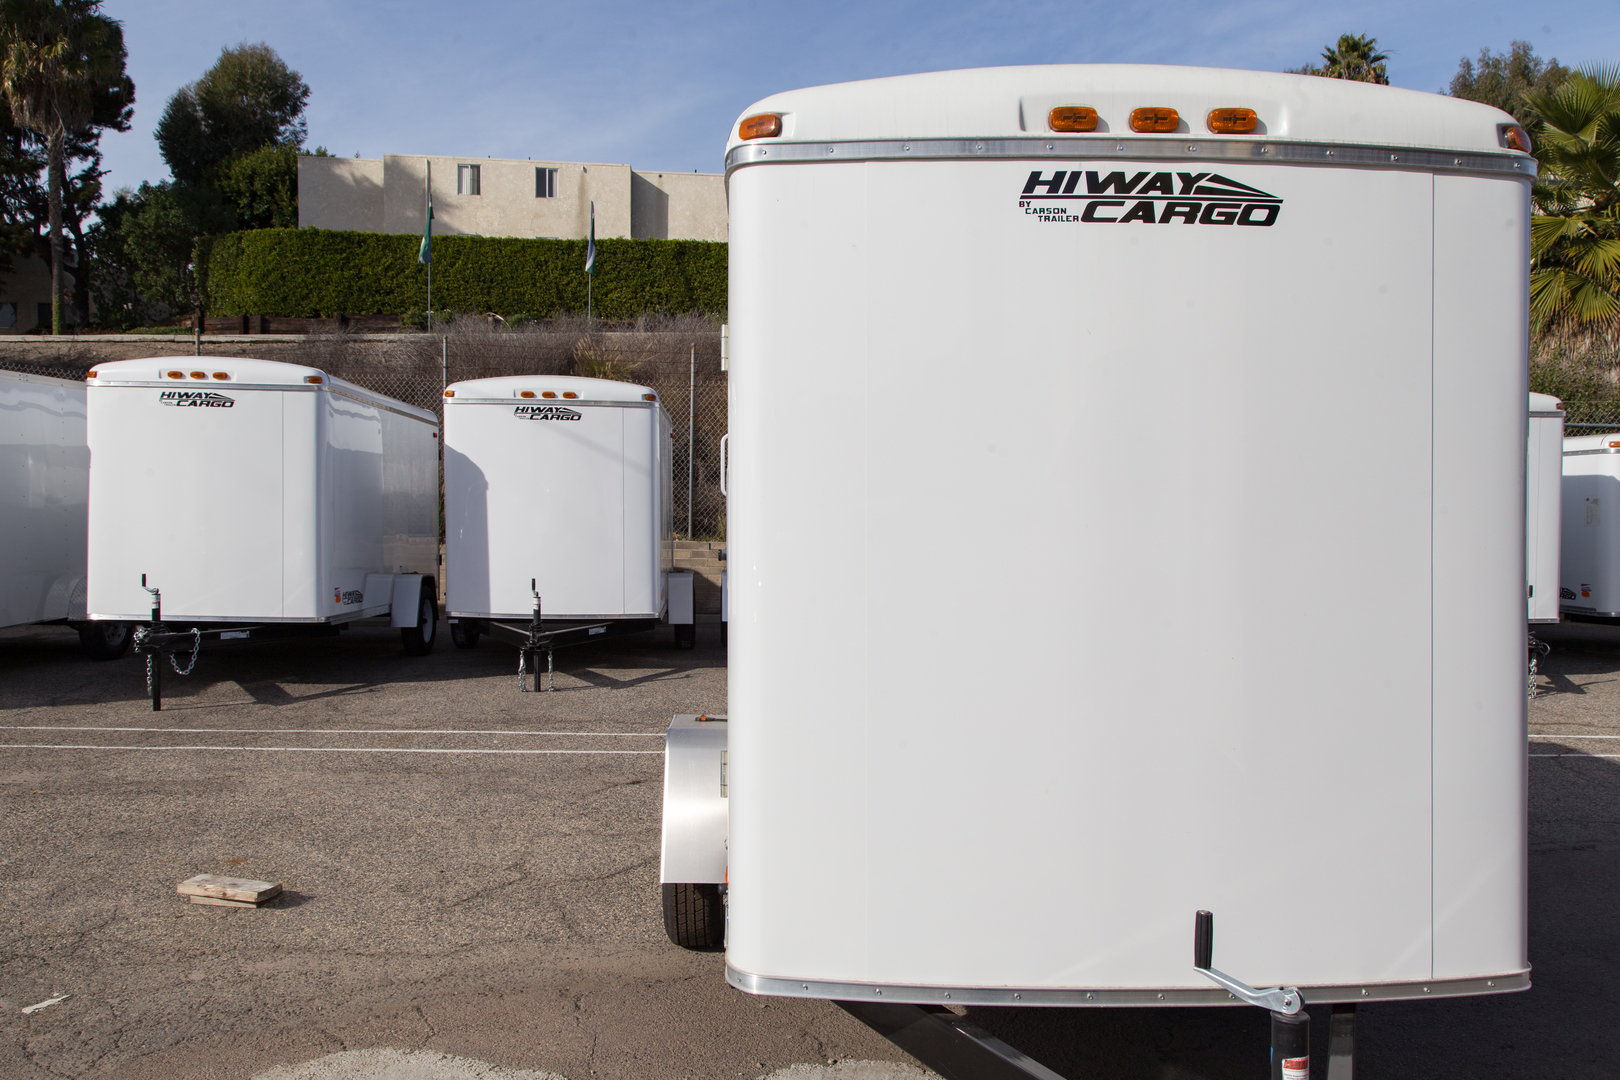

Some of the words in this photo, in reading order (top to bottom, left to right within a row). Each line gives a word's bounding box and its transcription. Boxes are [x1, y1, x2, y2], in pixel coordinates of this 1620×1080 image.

[1022, 171, 1212, 196] HIWAY
[1080, 201, 1281, 227] CARGO
[160, 391, 213, 399] HIWAY
[176, 400, 235, 408] CARGO
